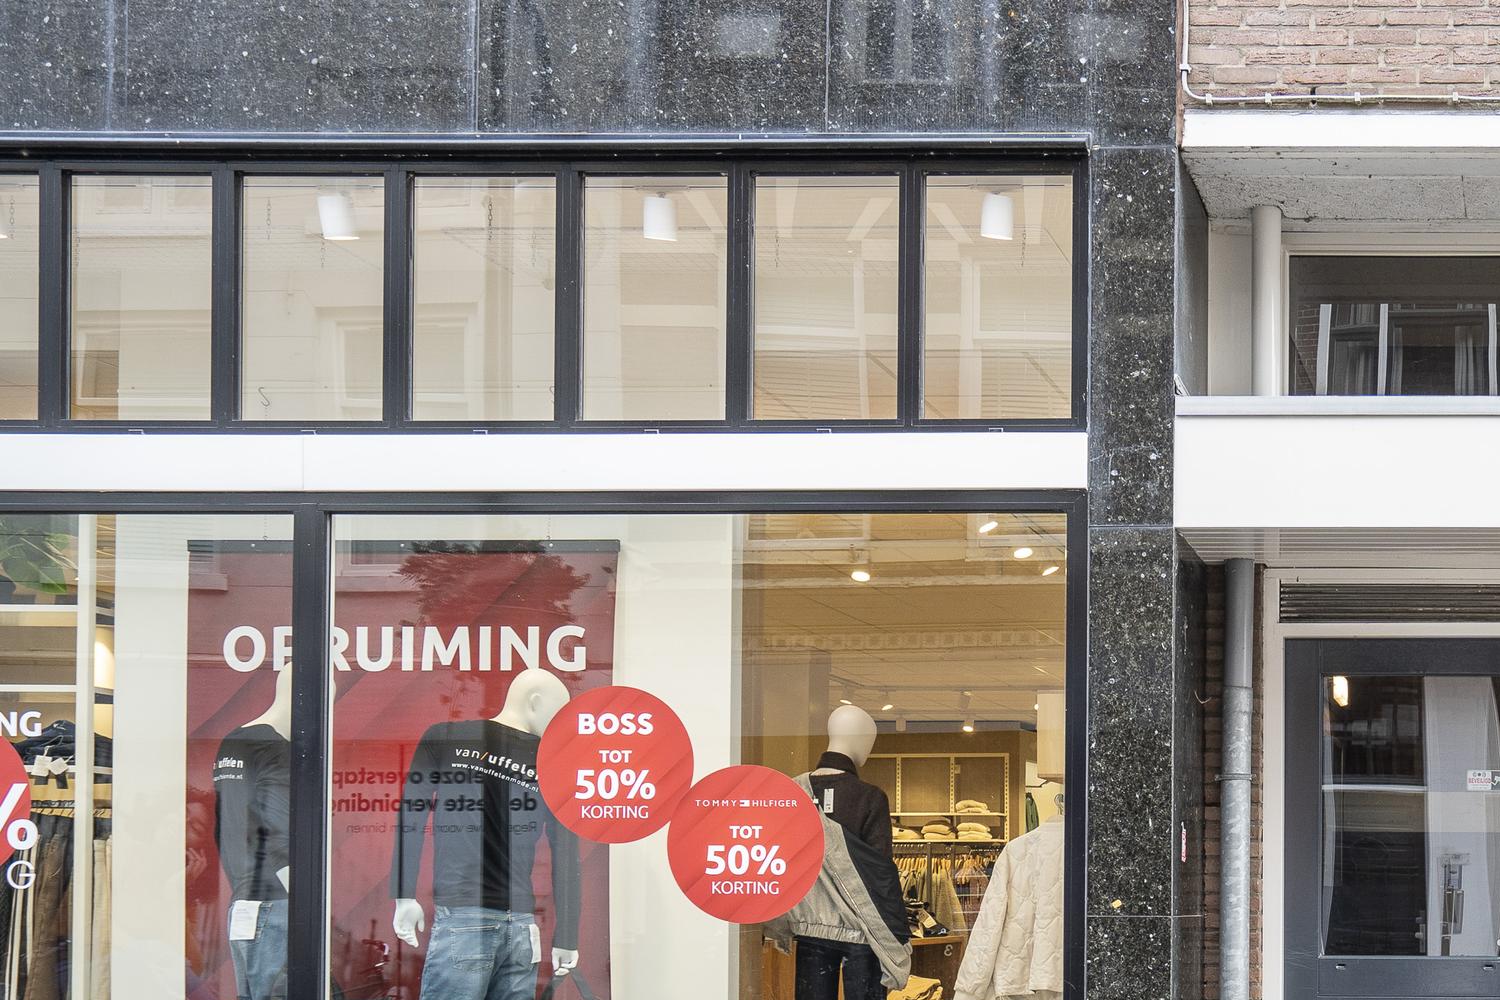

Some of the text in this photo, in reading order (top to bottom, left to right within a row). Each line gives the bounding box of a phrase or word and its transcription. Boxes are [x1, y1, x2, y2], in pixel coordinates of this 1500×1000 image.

[223, 625, 587, 672] OPRUIMING
[577, 713, 654, 735] BOSS
[599, 750, 632, 763] TOT
[575, 769, 656, 800] 50%
[696, 799, 797, 808] TOMMY HILFIGER
[581, 805, 650, 820] KORTING
[729, 825, 763, 839] TOT
[705, 845, 786, 876] 50%
[711, 881, 779, 895] KORTING
